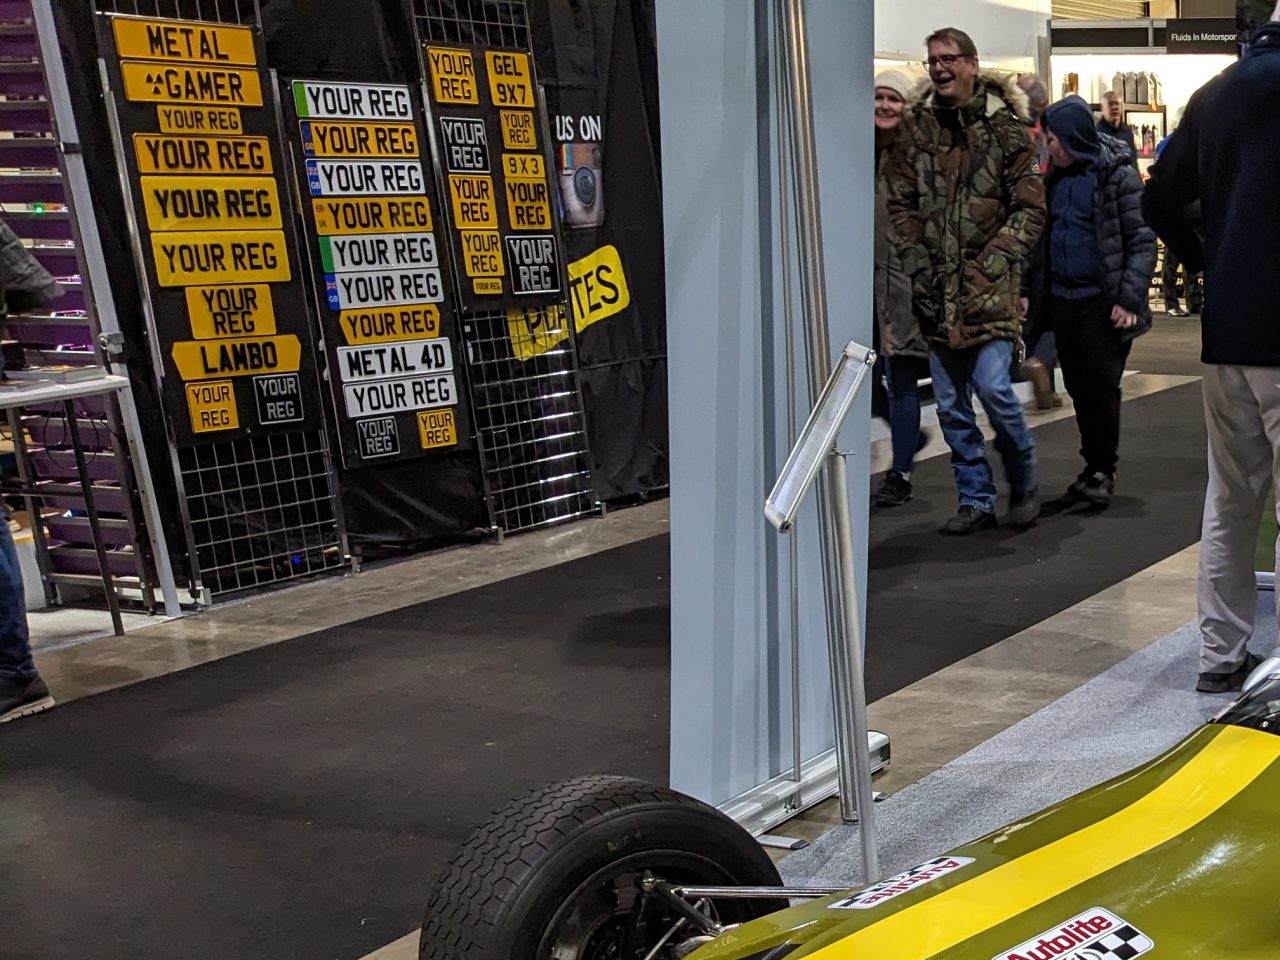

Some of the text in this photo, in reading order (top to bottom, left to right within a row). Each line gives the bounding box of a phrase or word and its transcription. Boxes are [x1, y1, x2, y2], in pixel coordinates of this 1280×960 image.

[147, 25, 229, 60] METAL
[1171, 33, 1192, 41] Fluids
[1193, 33, 1200, 41] In
[431, 53, 474, 76] YOUR
[493, 55, 523, 76] GEL
[165, 69, 244, 102] GAMER
[441, 79, 471, 100] REG
[497, 84, 527, 105] 9X7
[308, 87, 409, 117] YOUR REG
[163, 110, 239, 131] YOUR REG
[504, 113, 530, 129] YOUR
[556, 115, 601, 141] US ON
[314, 126, 415, 154] YOUR REG
[444, 122, 485, 145] YOUR
[508, 129, 530, 144] REG
[145, 140, 264, 170] YOUR REG
[451, 146, 483, 168] REG
[321, 165, 421, 191] YOUR REG
[451, 177, 489, 200] YOUR
[508, 181, 546, 203] YOUR
[153, 189, 272, 219] YOUR REG
[328, 201, 428, 229] YOUR REG
[460, 202, 490, 222] REG
[515, 205, 545, 225] REG
[334, 238, 433, 267] YOUR REG
[464, 234, 499, 253] YOUR
[510, 240, 554, 264] YOUR
[161, 242, 278, 274] YOUR REG
[471, 254, 498, 273] REG
[341, 273, 439, 304] YOUR REG
[519, 266, 551, 290] REG
[201, 288, 259, 313] YOUR
[522, 264, 620, 344] PLTES
[212, 311, 256, 335] REG
[347, 310, 435, 339] YOUR REG
[200, 341, 278, 374] LAMBO
[347, 344, 446, 377] METAL 4D
[192, 386, 231, 404] YOUR
[258, 376, 297, 398] YOUR
[353, 378, 450, 412] YOUR REG
[201, 409, 230, 428] REG
[266, 400, 295, 420] REG
[360, 420, 395, 438] YOUR
[420, 414, 452, 430] YOUR
[366, 436, 393, 454] REG
[427, 429, 451, 443] REG
